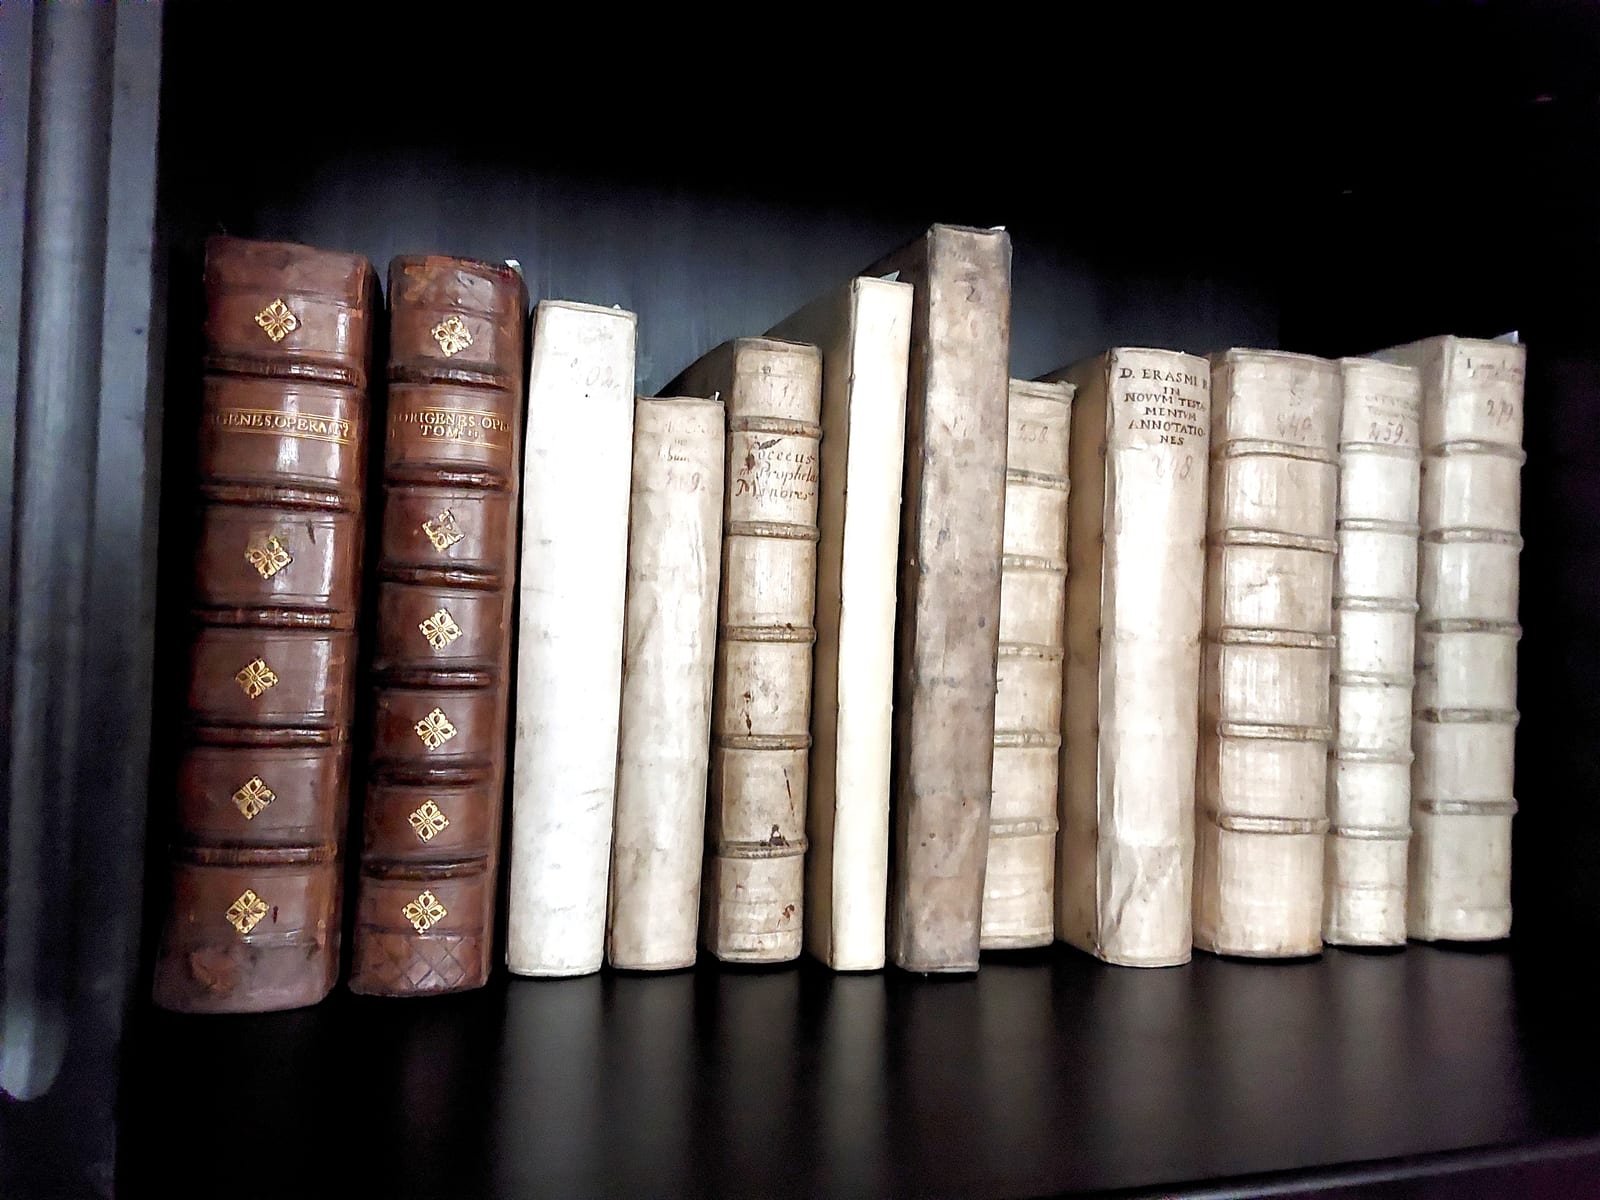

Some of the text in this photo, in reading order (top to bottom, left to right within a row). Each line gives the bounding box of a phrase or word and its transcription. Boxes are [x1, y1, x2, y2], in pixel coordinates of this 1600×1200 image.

[1162, 386, 1181, 396] IN
[1124, 392, 1174, 405] NOVVM
[1144, 406, 1197, 421] MENTVM
[1159, 434, 1185, 446] NES
